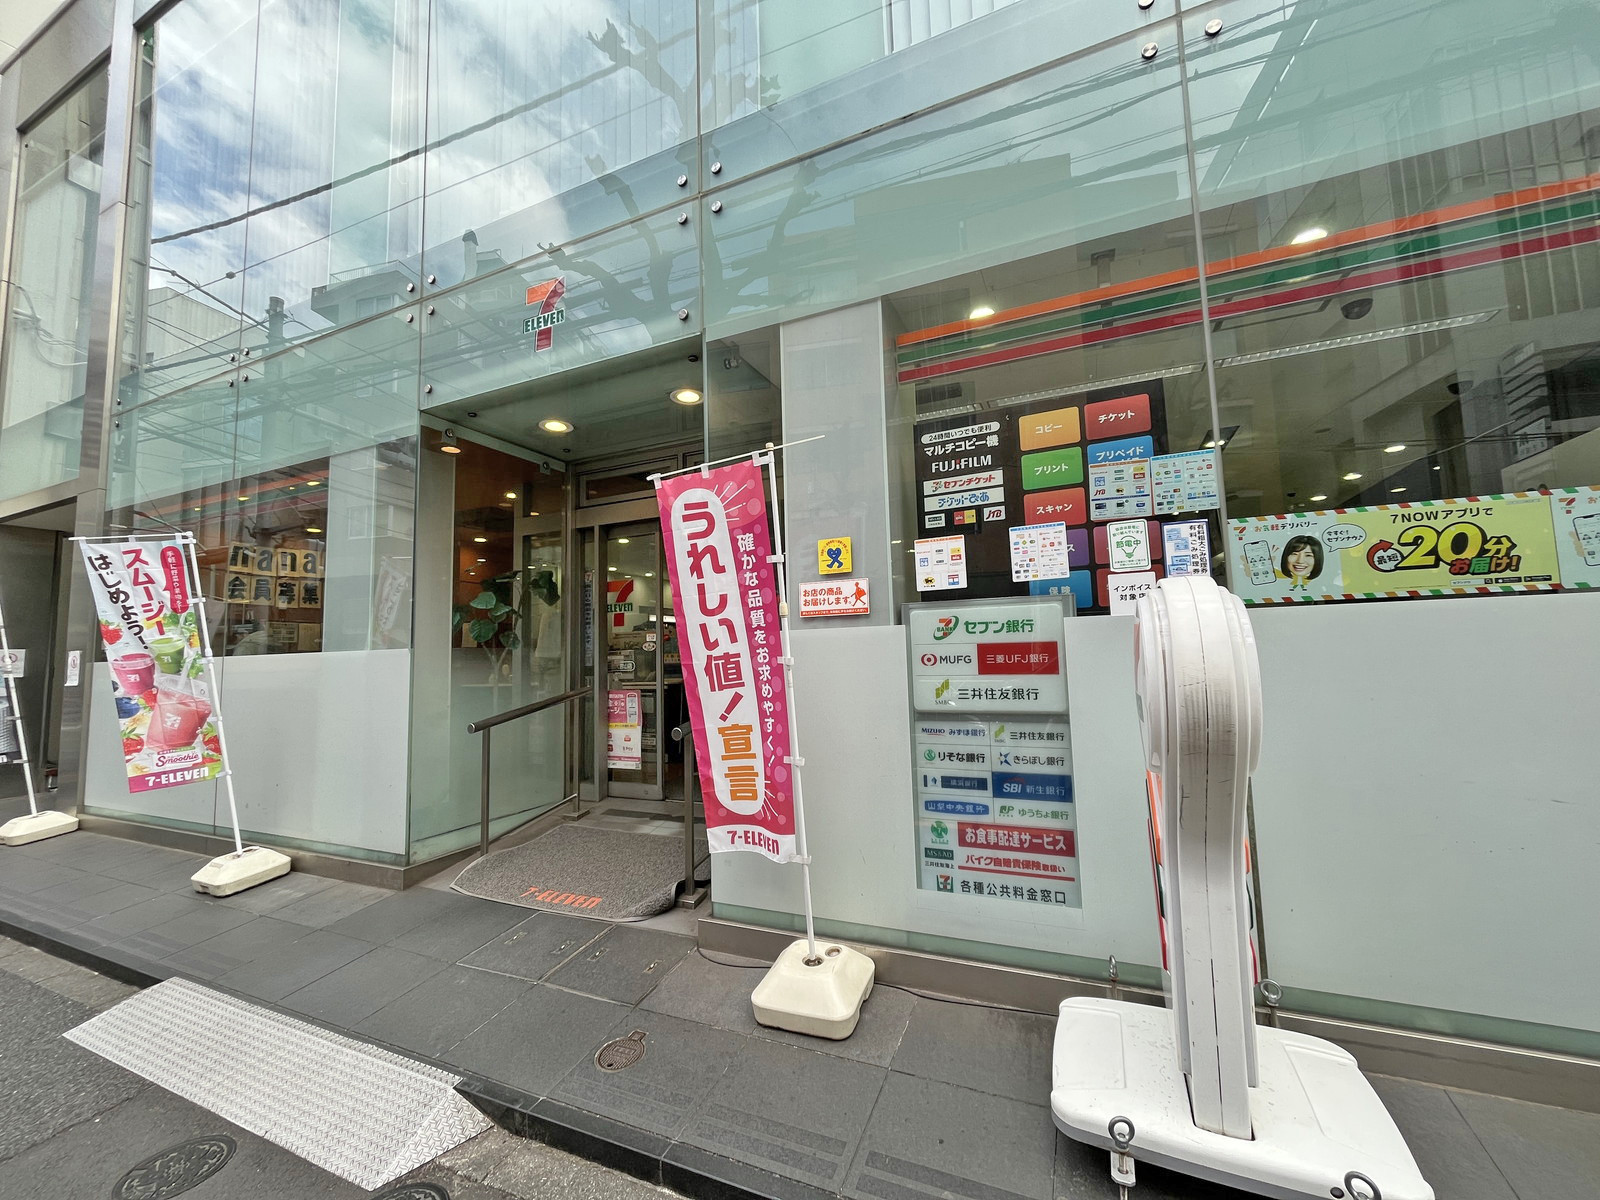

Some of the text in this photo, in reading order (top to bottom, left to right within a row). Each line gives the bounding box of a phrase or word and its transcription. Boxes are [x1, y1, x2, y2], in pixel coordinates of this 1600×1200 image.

[1098, 410, 1135, 423] チケット
[928, 424, 992, 442] 24時間いつでも便利
[1035, 424, 1063, 434] コピー
[924, 434, 999, 457] マルチコピー機
[1096, 446, 1144, 461] プリペイド
[931, 455, 992, 473] FUJIFILM
[1034, 463, 1069, 475] プリント
[943, 474, 996, 489] セブンチケット
[1036, 503, 1073, 515] スキャン
[1390, 507, 1494, 524] 7NOWアプリで
[1254, 521, 1318, 532] お気軽デリバリー
[1189, 524, 1200, 575] 有料ごみ処理券
[121, 548, 165, 636] スムージー
[227, 576, 319, 605] 会員募集
[802, 587, 843, 598] お店の商品
[1113, 583, 1152, 593] インボイス
[87, 553, 149, 650] はじめよう!
[964, 619, 1034, 634] セブン銀行
[939, 655, 972, 664] MUFG
[986, 653, 1049, 664] 三菱UFJ銀行
[957, 688, 1040, 700] 三井住友銀行
[949, 728, 986, 737] みずほ銀行
[1009, 731, 1065, 741] 三井住友銀行
[155, 751, 200, 768] Smoothie
[938, 752, 986, 763] りそな銀行
[1013, 755, 1065, 767] きらぼし銀行
[1002, 782, 1022, 793] SBI
[1026, 785, 1065, 796] 新生銀行
[927, 802, 985, 814] 山梨中央銀行
[1018, 808, 1069, 820] ゆうちょ銀行
[965, 827, 1067, 850] お食事配達サービス
[960, 880, 1066, 905] 各種公共料金窓口
